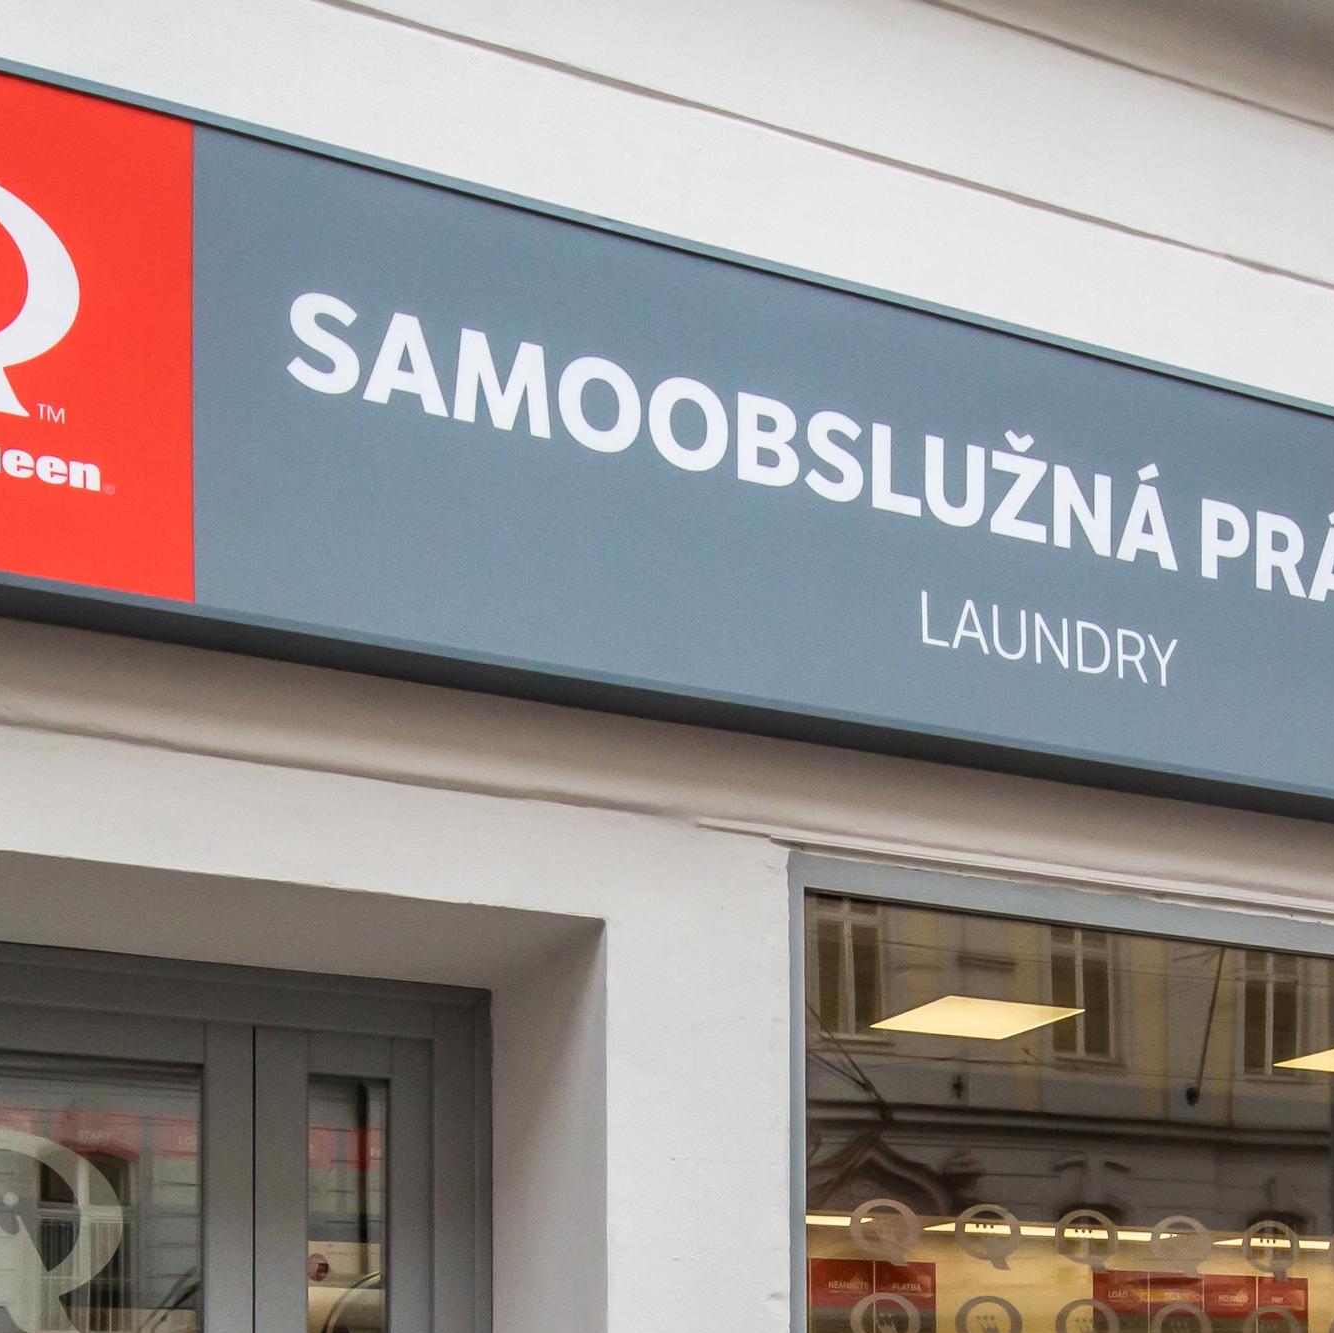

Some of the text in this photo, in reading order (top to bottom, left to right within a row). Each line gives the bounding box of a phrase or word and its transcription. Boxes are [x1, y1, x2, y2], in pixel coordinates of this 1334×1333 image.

[37, 403, 66, 425] TM
[287, 292, 1178, 571] SAMOOBSLUŽNÁ
[921, 590, 1178, 687] LAUNDRY
